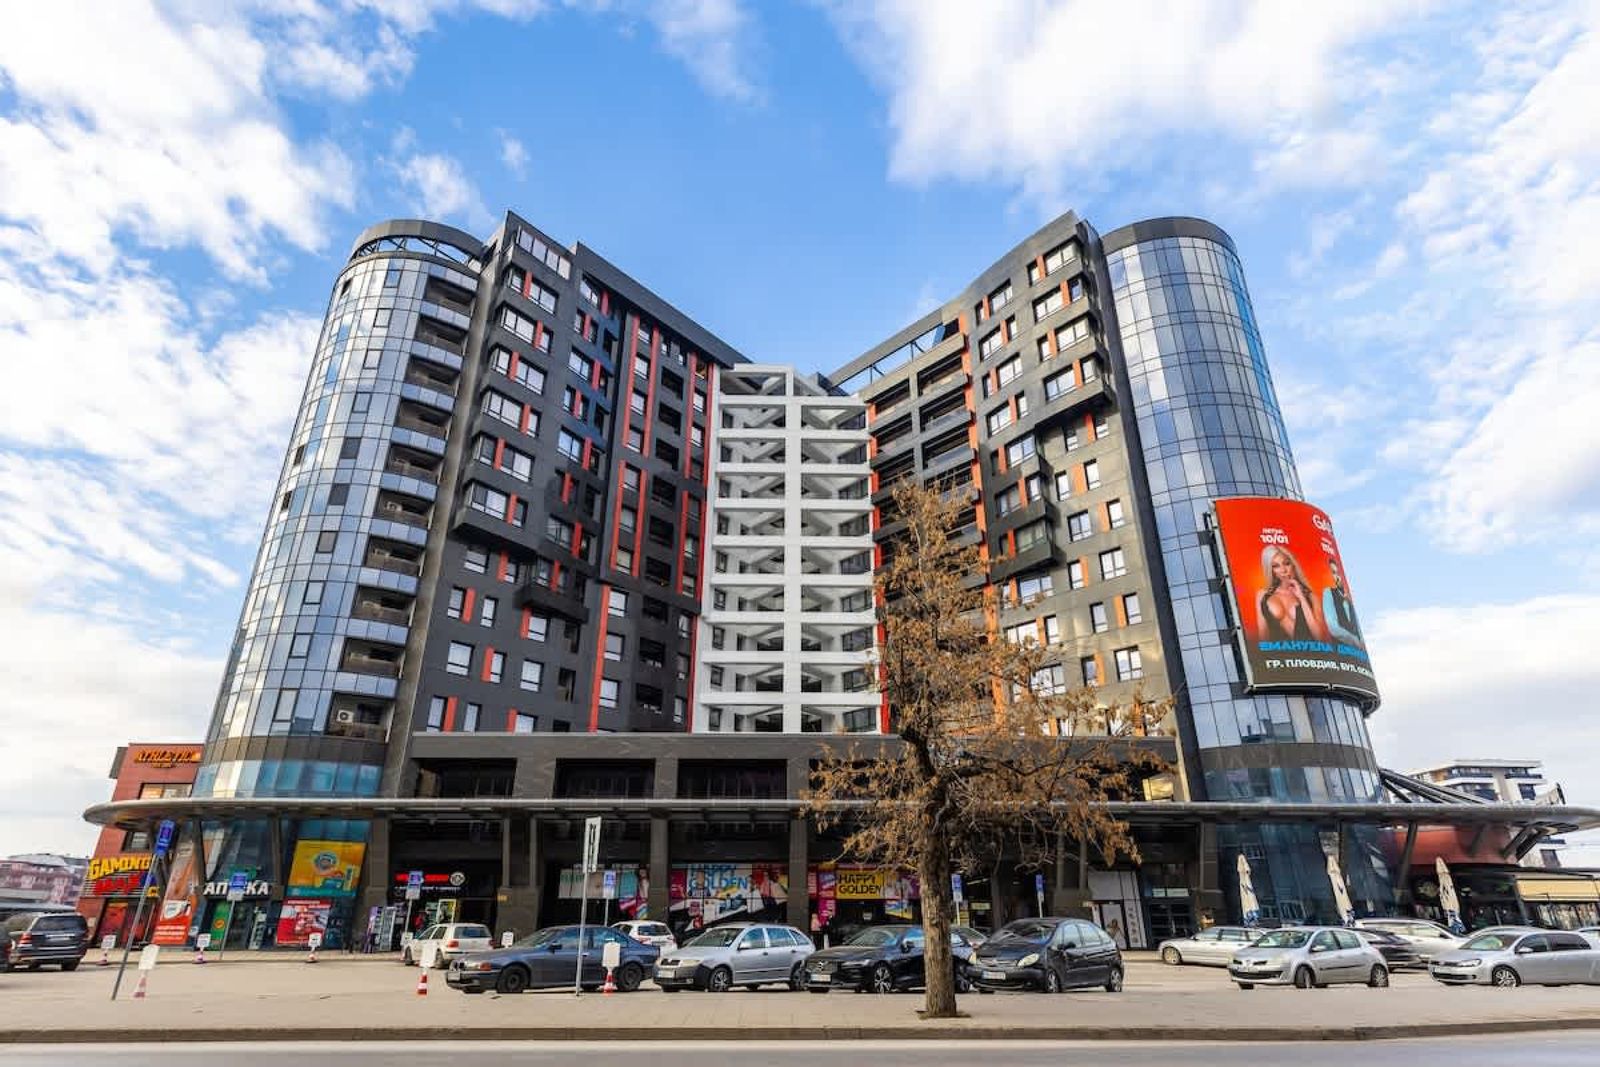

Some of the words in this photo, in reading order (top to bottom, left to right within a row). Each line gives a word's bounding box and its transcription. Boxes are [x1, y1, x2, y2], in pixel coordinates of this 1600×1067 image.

[1259, 534, 1289, 545] 10/01
[1265, 659, 1284, 669] ГР.
[203, 882, 269, 896] АПКА
[838, 885, 881, 895] GOLDEN
